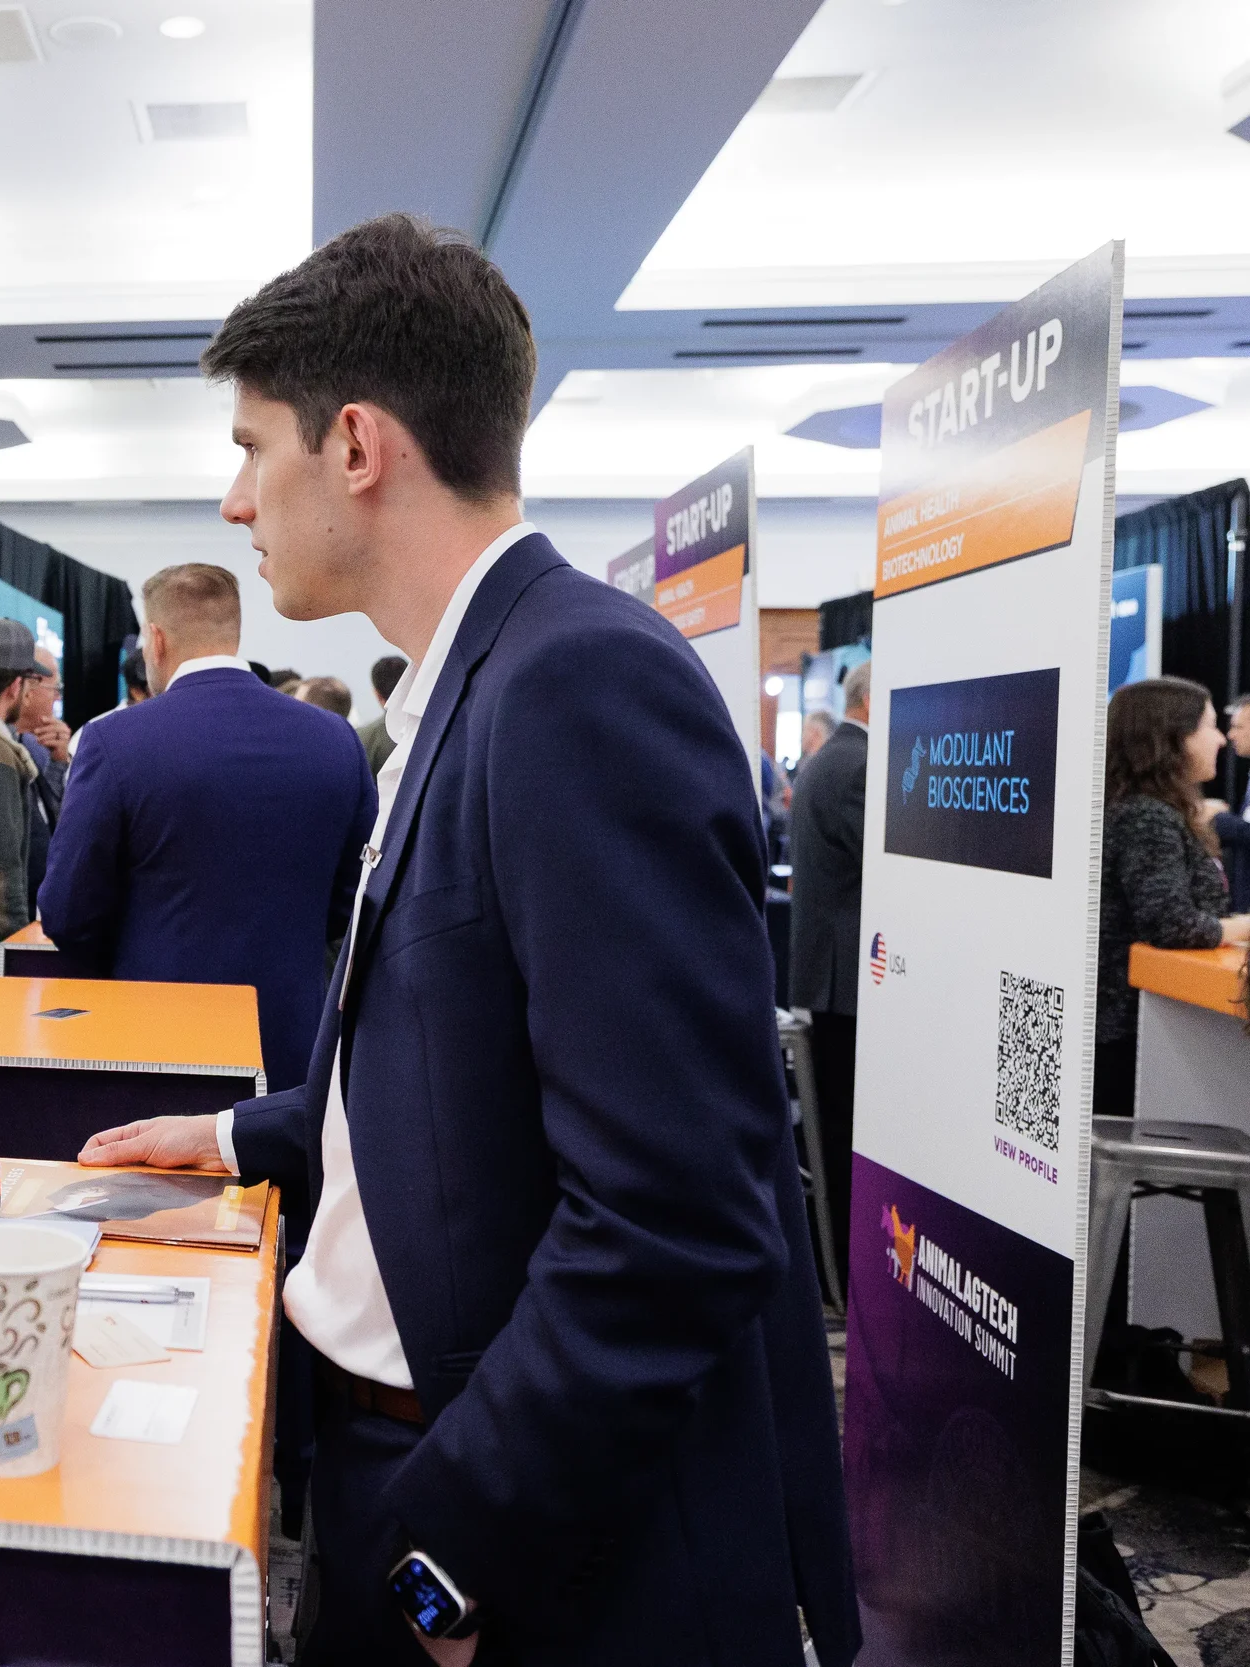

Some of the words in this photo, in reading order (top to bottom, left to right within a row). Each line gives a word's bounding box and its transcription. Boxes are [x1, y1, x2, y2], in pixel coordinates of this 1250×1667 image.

[908, 318, 1063, 449] START-UP
[666, 483, 733, 556] START-UP
[883, 506, 919, 538] ANIMAL
[882, 534, 965, 581] BIOTECHNOLOGY
[929, 730, 1015, 766] MODULANT
[928, 776, 1030, 814] BIOSCIENCES
[889, 955, 907, 977] USA
[993, 1135, 1017, 1161] VIEW
[1019, 1149, 1058, 1185] PROFILE
[918, 1234, 1018, 1344] ANIMALAGTECH
[916, 1273, 973, 1344] INNOVATION
[975, 1324, 1017, 1380] SUMMIT
